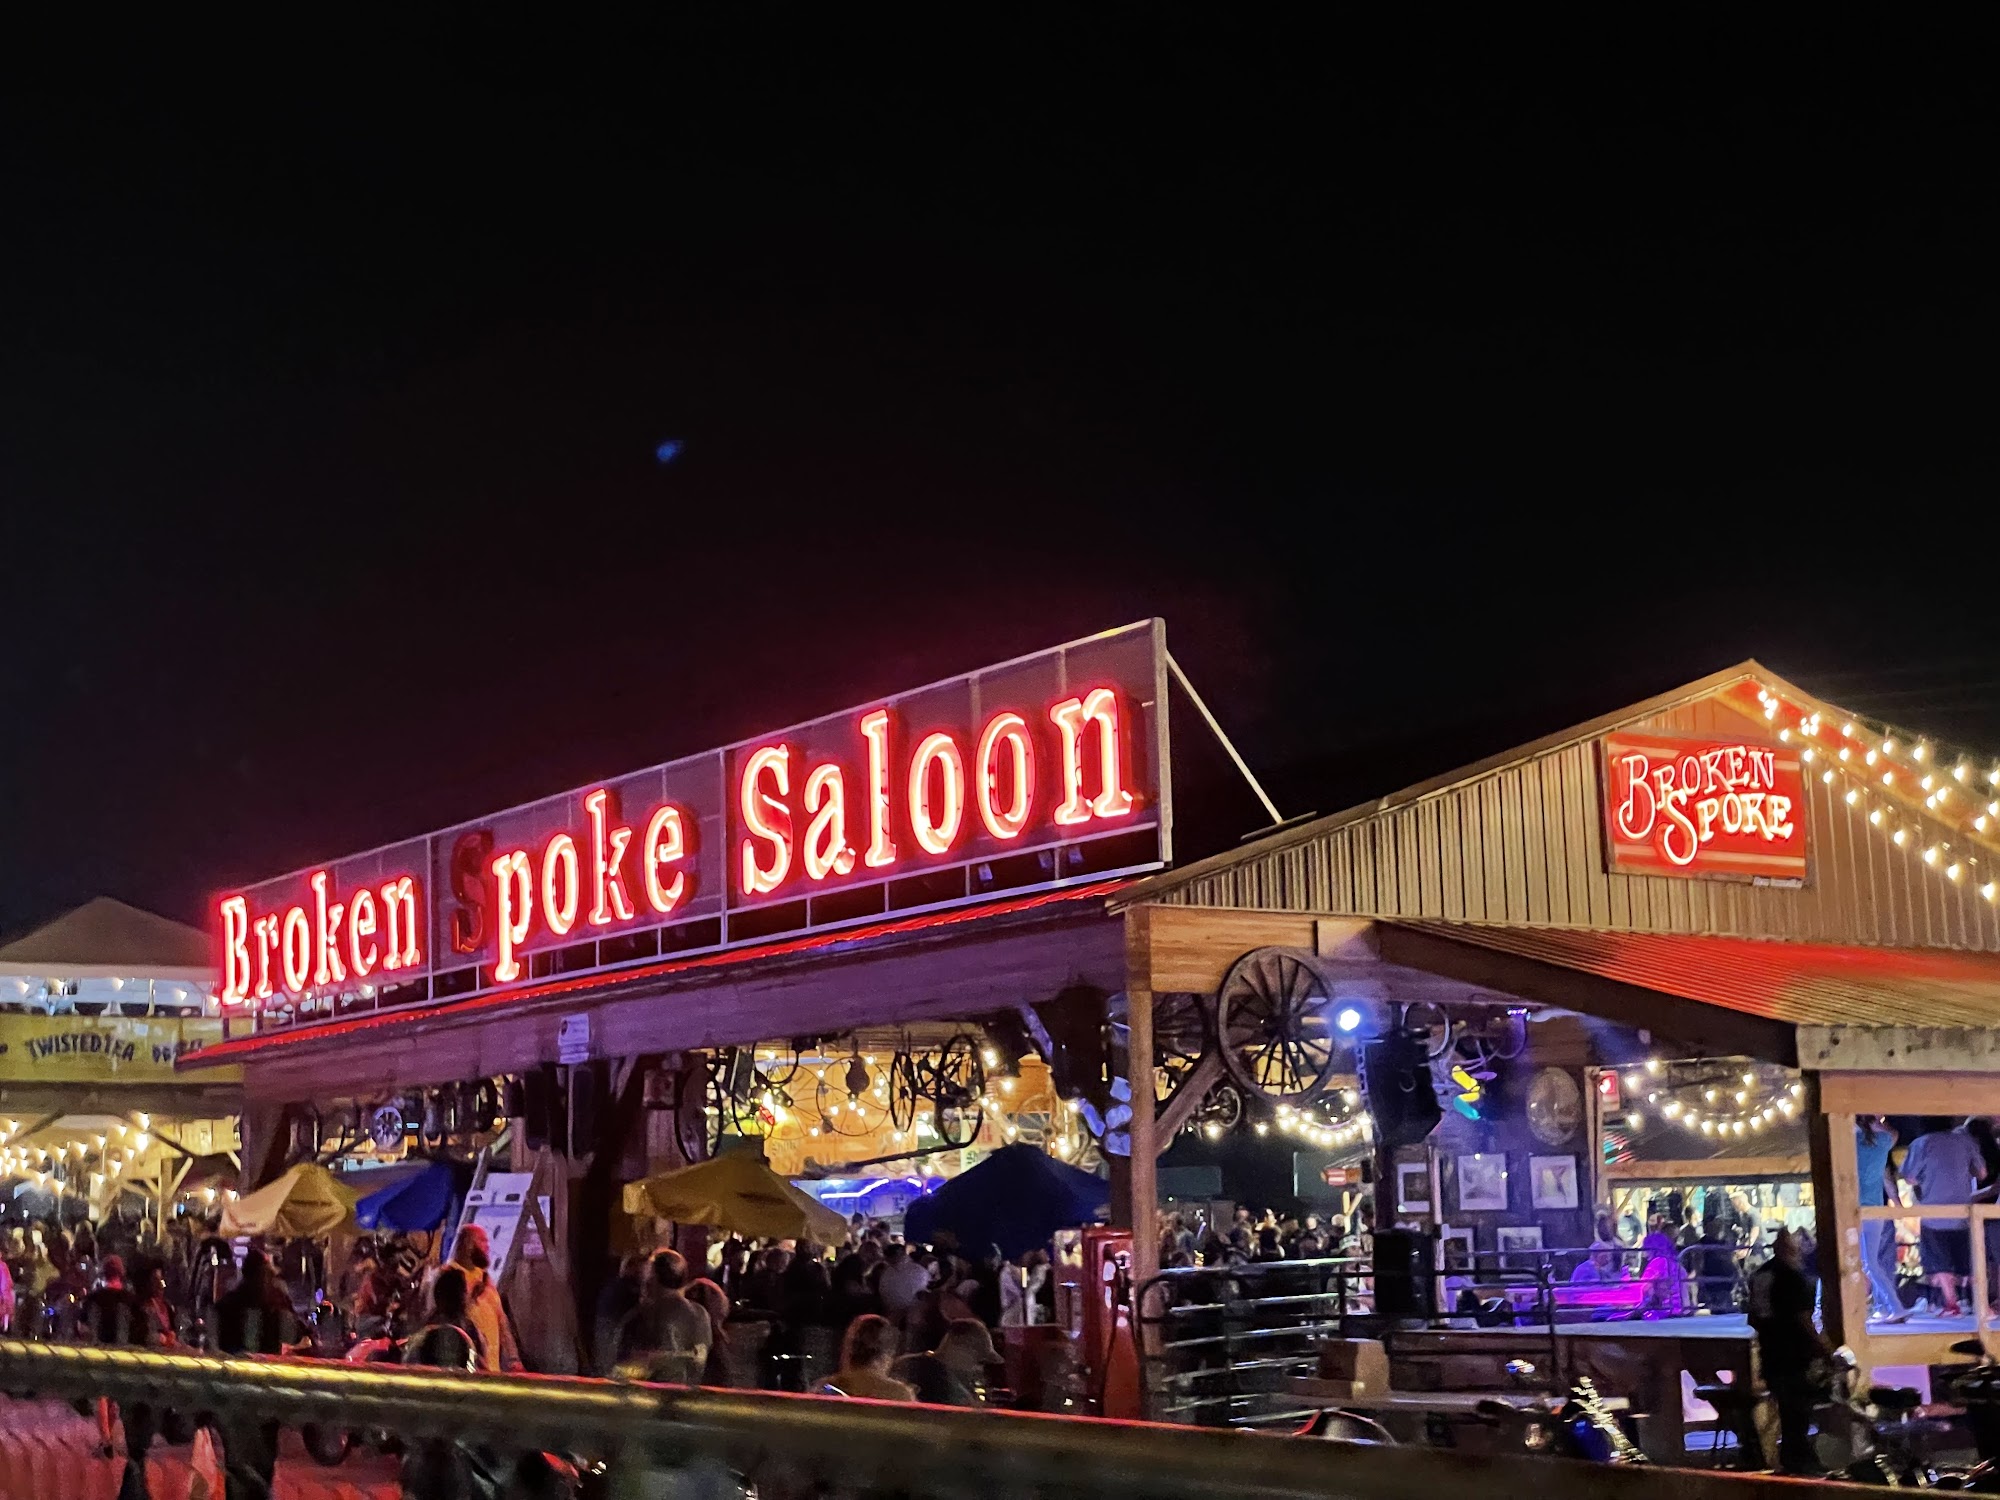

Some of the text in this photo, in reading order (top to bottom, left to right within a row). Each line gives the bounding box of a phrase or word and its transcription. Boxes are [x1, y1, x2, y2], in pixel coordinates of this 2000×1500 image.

[1617, 745, 1775, 840] BROKEN
[1661, 788, 1794, 866] SPOKE
[219, 687, 1134, 1006] Broken Spoke Saloon
[25, 1032, 102, 1060] TWISTED
